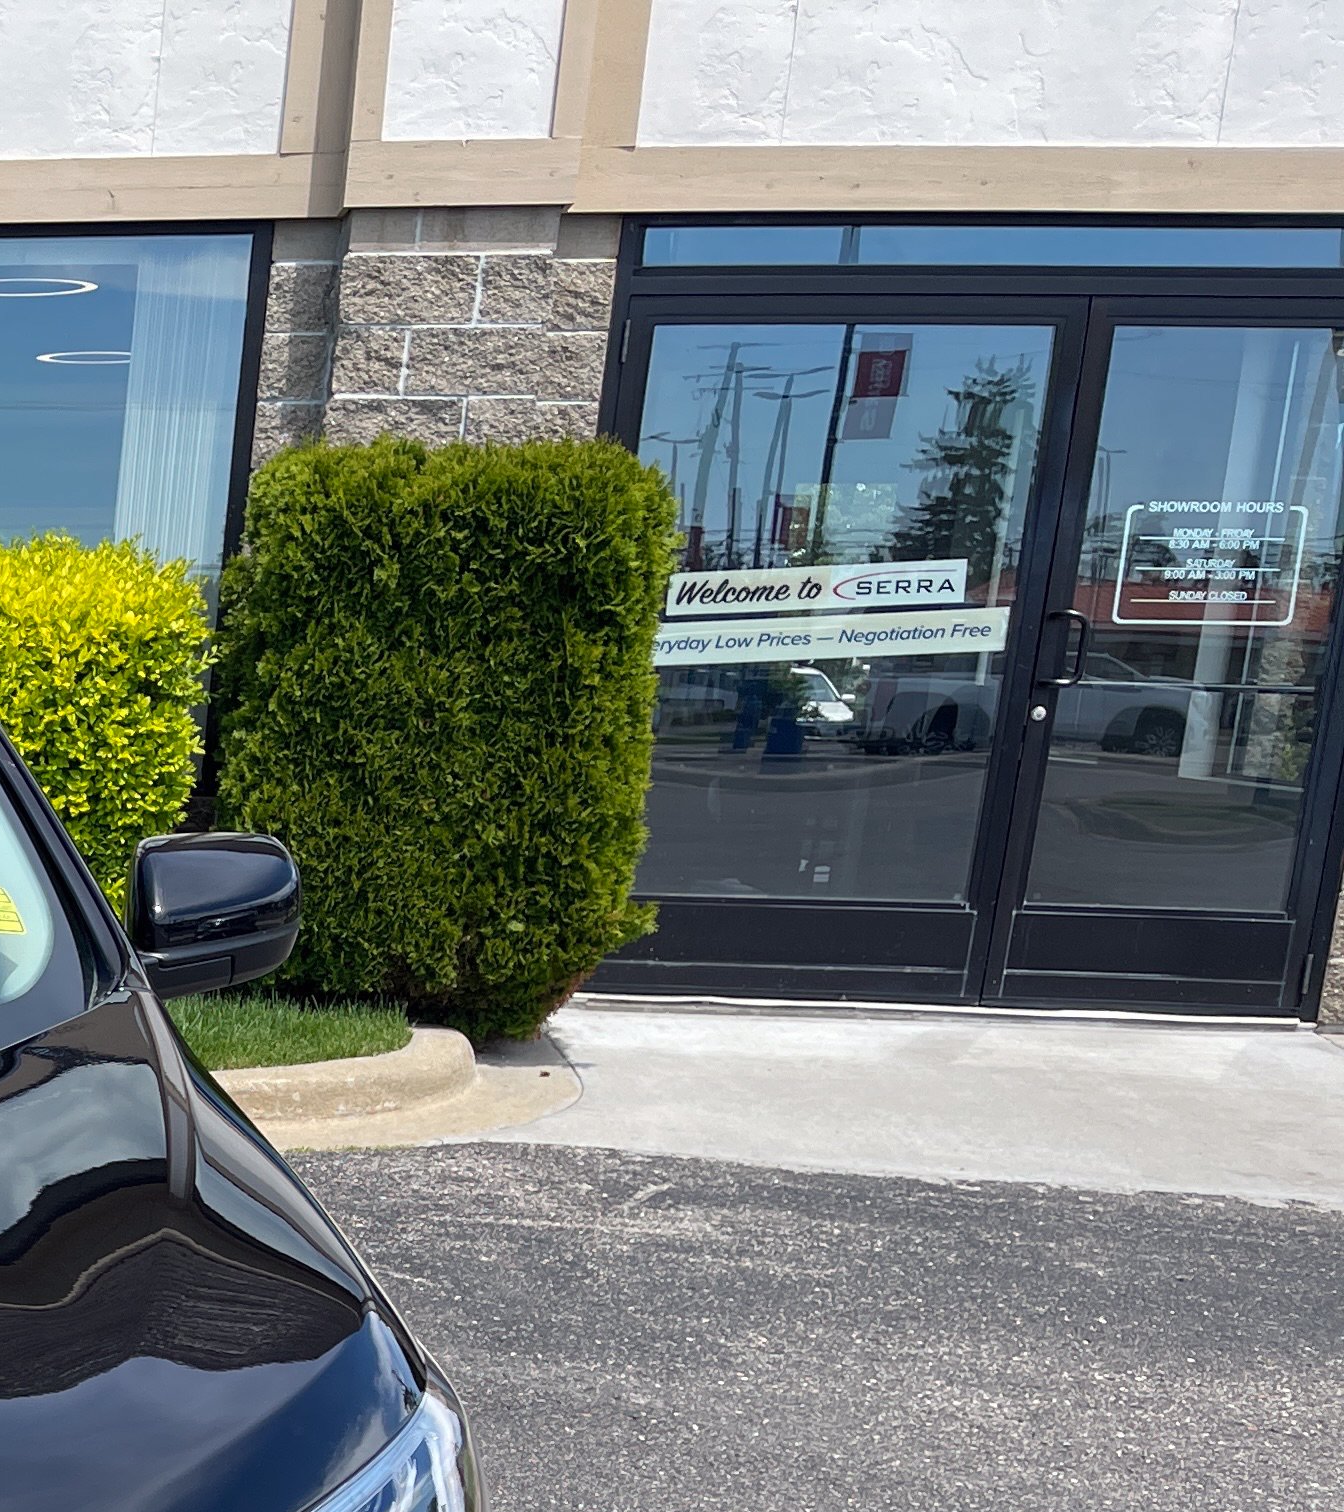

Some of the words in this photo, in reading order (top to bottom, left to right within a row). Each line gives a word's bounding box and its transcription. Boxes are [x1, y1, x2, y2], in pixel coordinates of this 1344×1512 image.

[1148, 501, 1232, 513] SHOWROOM
[1236, 501, 1285, 513] HOURS
[1172, 528, 1214, 538] MONDAY
[1220, 529, 1255, 539] FRIDAY
[1168, 540, 1190, 549] 8:30
[1192, 540, 1211, 549] AM
[1219, 540, 1240, 550] 6:00
[1243, 541, 1261, 550] PM
[1186, 559, 1236, 569] SATURDAY
[1164, 570, 1185, 580] 9:00
[1188, 571, 1207, 580] AM
[1239, 571, 1256, 581] PM
[675, 580, 791, 606] Welcome
[797, 576, 823, 600] to
[855, 577, 956, 596] SERRA
[1168, 591, 1207, 600] SUNDAY
[1208, 591, 1248, 601] CLOSED
[653, 636, 712, 655] eryday
[715, 635, 755, 649] Low
[758, 631, 812, 647] Prices
[838, 624, 947, 646] Negotiation
[951, 622, 992, 638] Free
